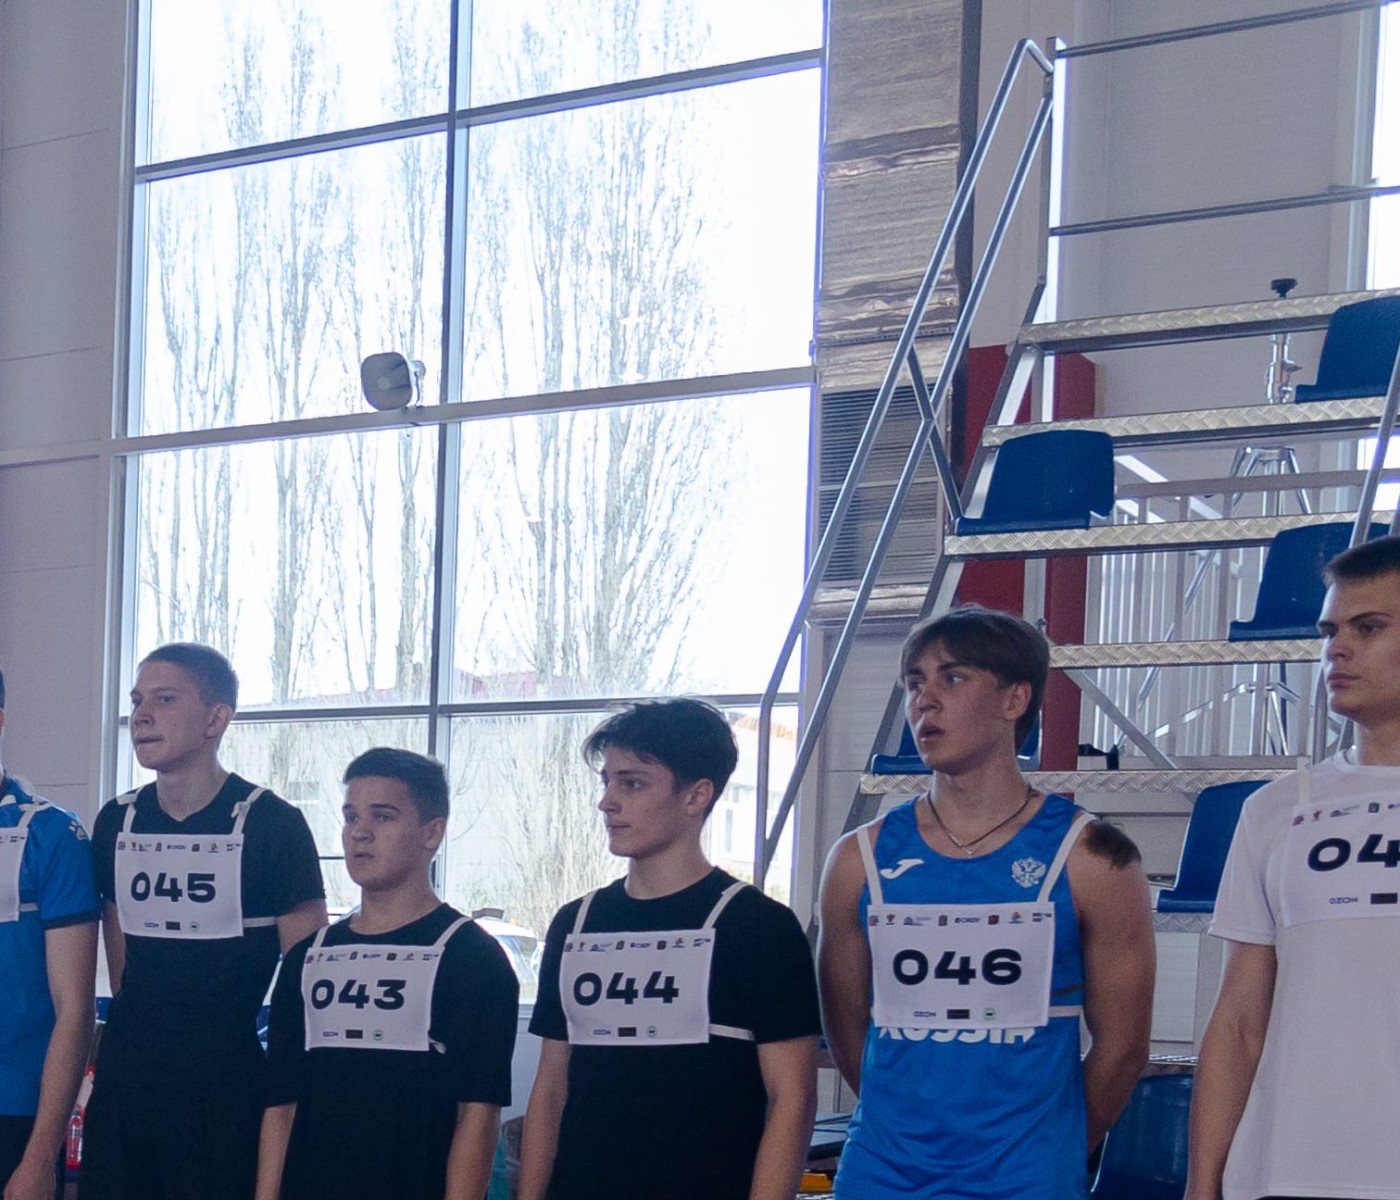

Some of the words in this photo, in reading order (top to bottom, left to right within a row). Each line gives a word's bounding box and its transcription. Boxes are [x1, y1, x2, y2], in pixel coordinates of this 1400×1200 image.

[1307, 833, 1400, 872] 04
[131, 872, 216, 903] 045
[893, 949, 1022, 985] 046
[311, 979, 406, 1010] 043
[573, 971, 679, 1006] 044
